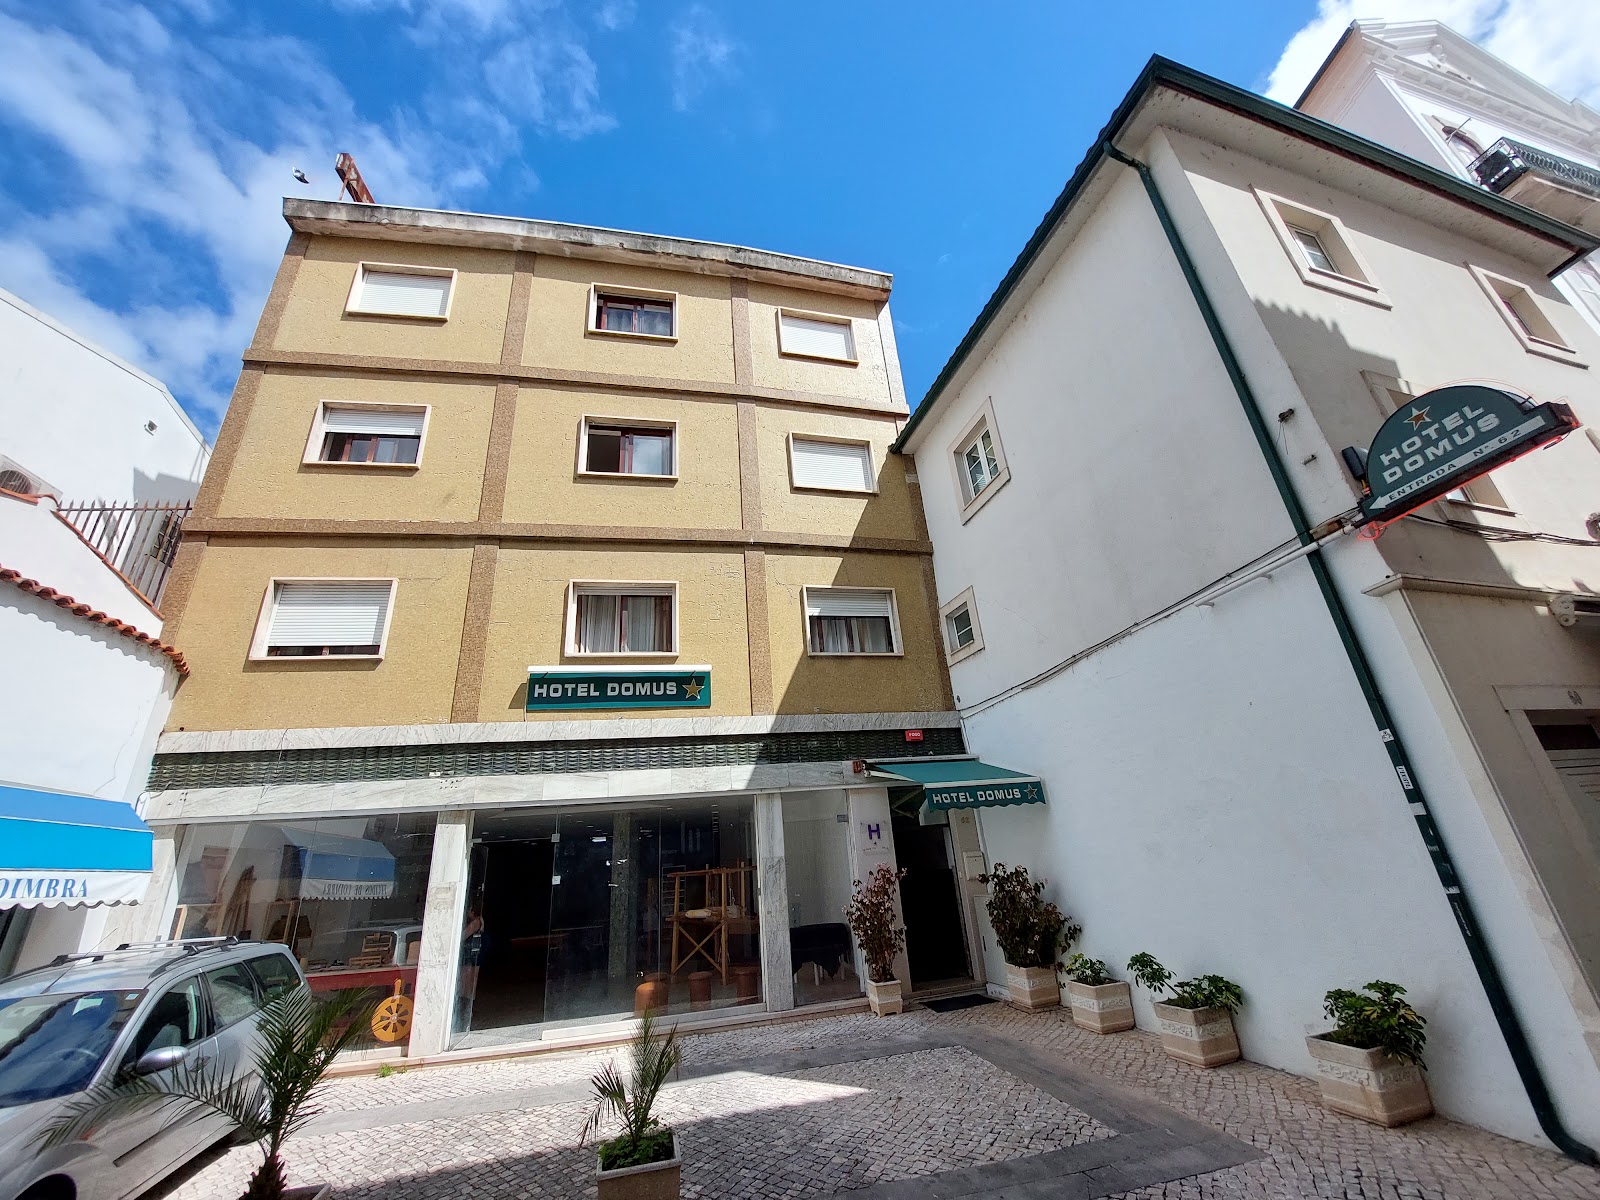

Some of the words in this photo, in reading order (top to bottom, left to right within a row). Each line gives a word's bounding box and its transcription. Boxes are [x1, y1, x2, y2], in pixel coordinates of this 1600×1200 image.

[1380, 406, 1484, 466] HOTEL
[1382, 413, 1500, 484] DOMUS
[1388, 464, 1457, 500] ENTRADA
[1498, 429, 1521, 444] 62
[534, 683, 600, 698] HOTEL
[607, 681, 677, 696] DOMUS
[933, 793, 974, 803] HOTEL
[976, 788, 1021, 801] DOMUS
[867, 823, 881, 840] H
